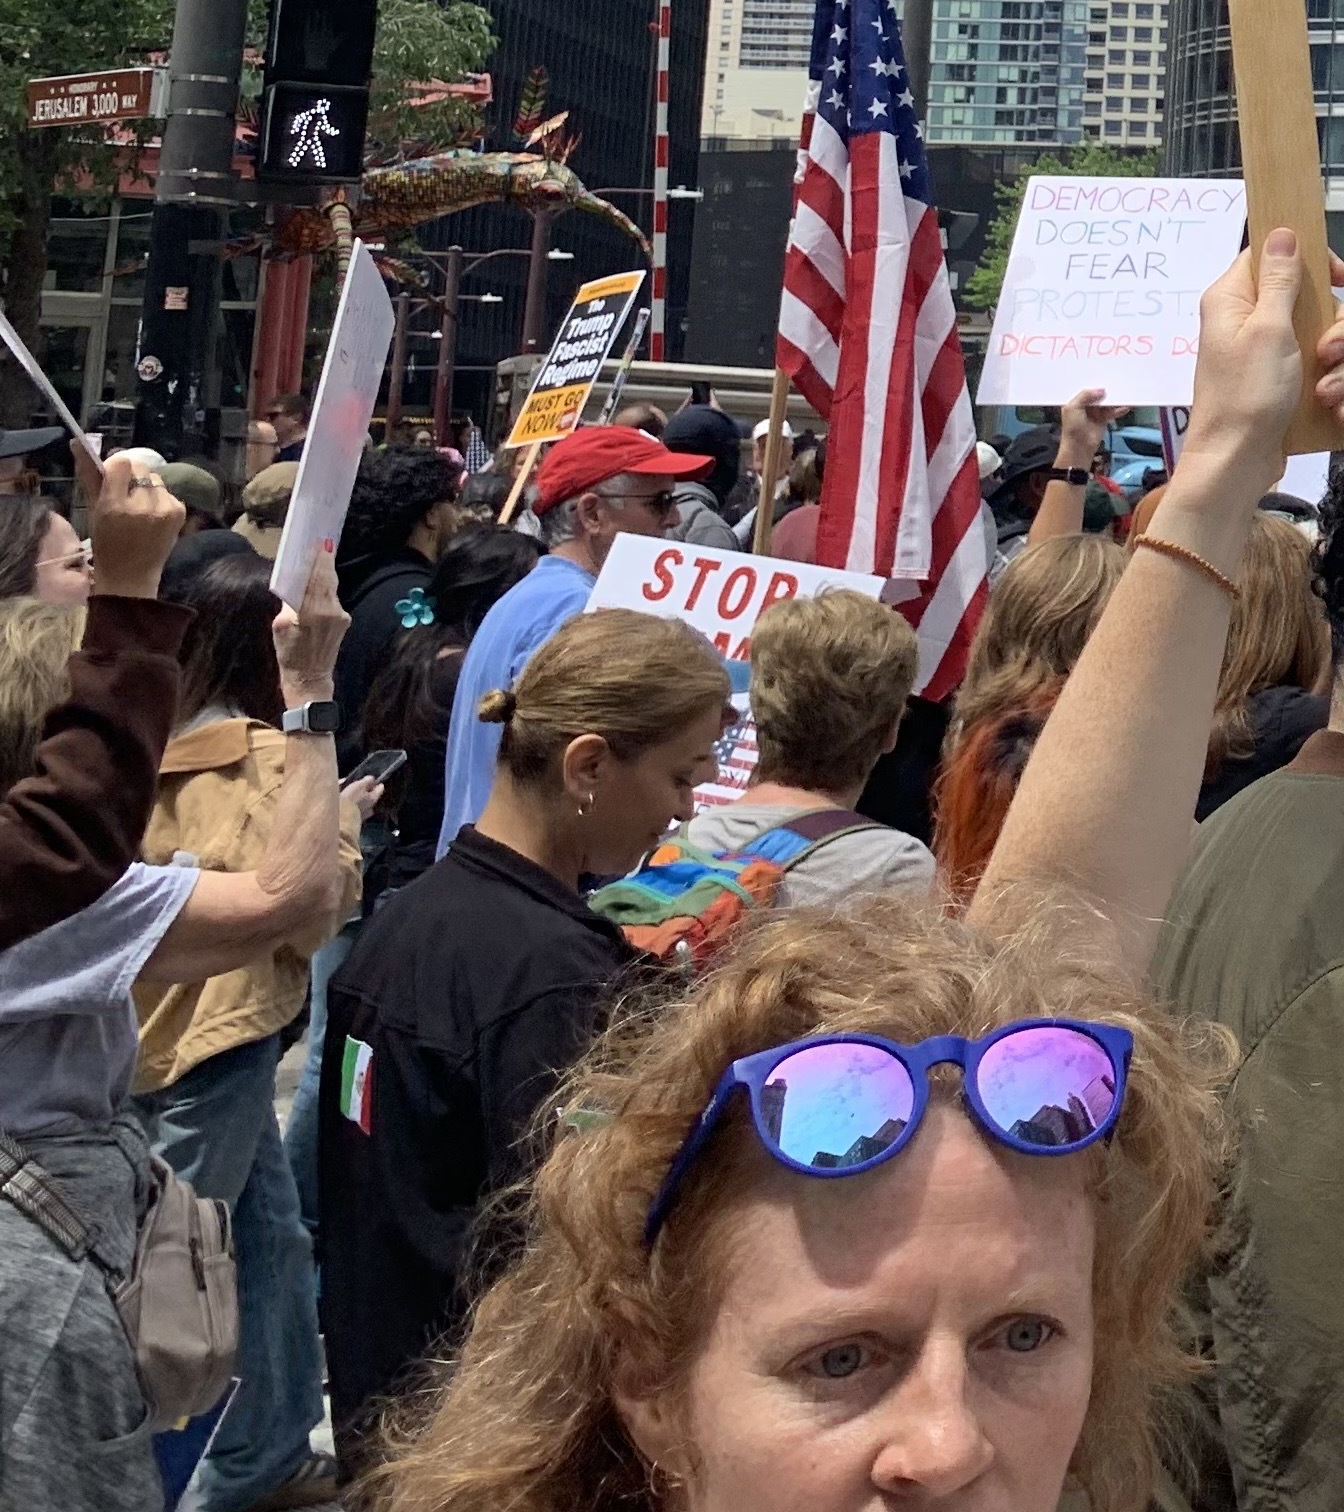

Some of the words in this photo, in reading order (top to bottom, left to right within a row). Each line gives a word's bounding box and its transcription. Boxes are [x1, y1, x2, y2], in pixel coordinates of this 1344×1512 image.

[32, 96, 88, 121] JERUSALEM
[122, 93, 138, 108] WAY
[1030, 184, 1243, 213] DEMOCRACY
[1035, 217, 1207, 246] DOESN'T
[1065, 251, 1169, 280] FEAR
[588, 299, 606, 314] The
[566, 312, 615, 340] Trump
[551, 331, 609, 364] Fascist
[1000, 334, 1154, 361] DICTATORS
[539, 359, 599, 387] Regime
[526, 393, 560, 413] MUST
[564, 389, 585, 407] GO
[642, 548, 799, 621] STOP
